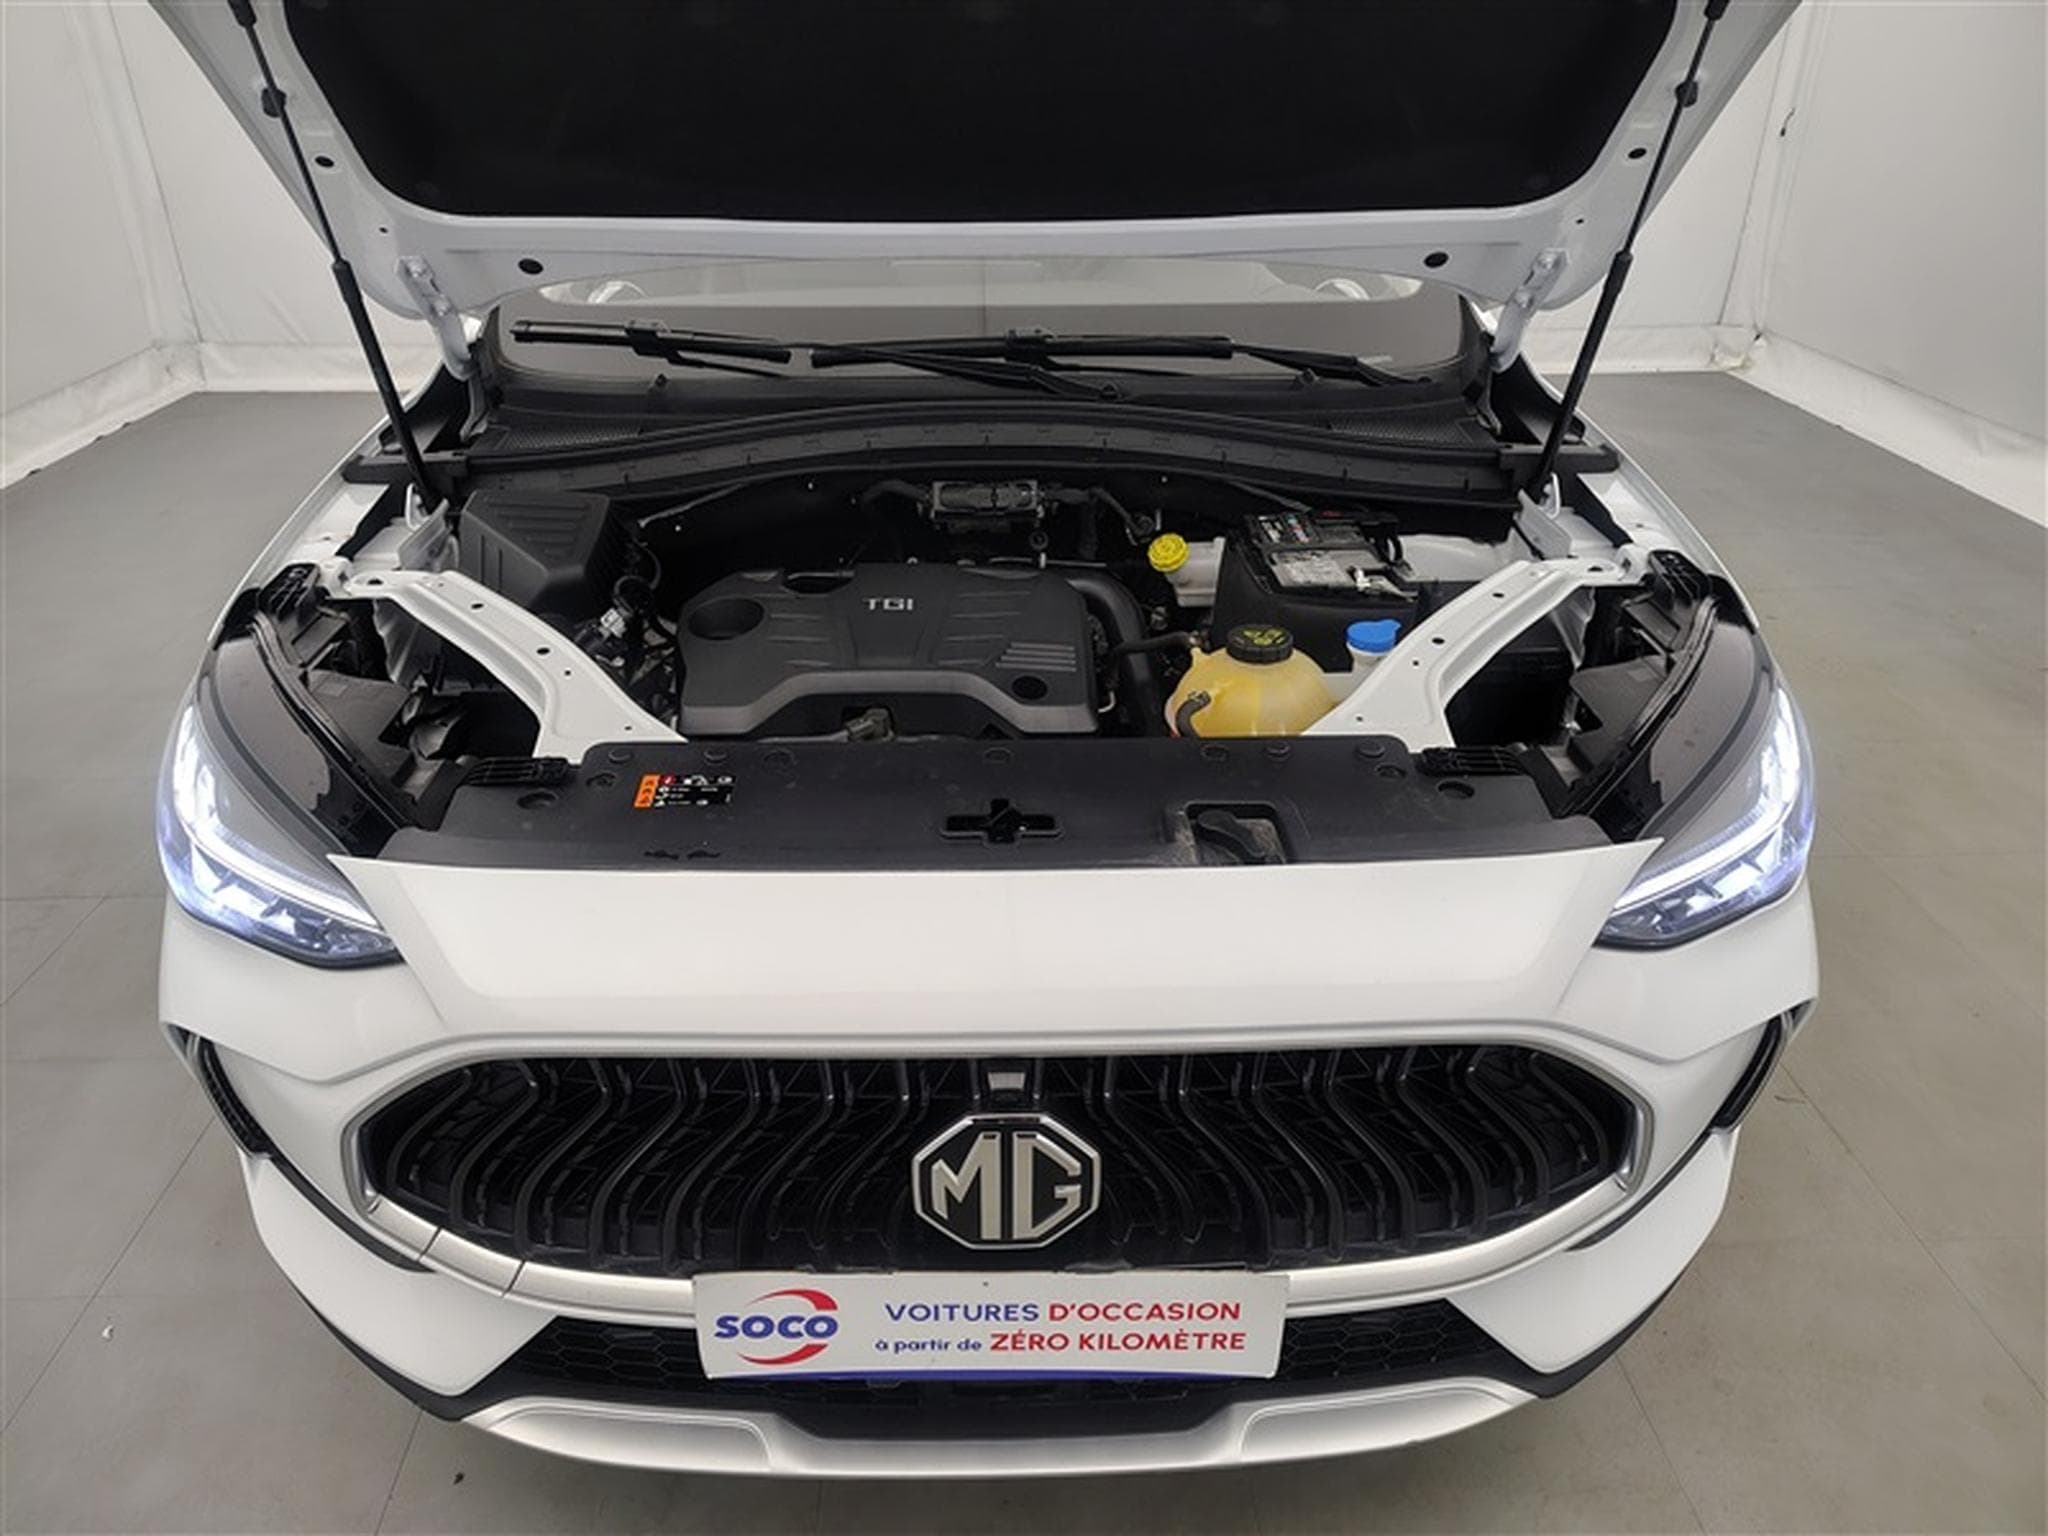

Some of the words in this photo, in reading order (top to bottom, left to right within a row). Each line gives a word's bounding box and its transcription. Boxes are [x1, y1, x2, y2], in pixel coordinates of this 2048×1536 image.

[864, 598, 913, 610] TGI
[931, 1132, 1081, 1240] MG
[886, 1303, 1040, 1322] VOITURES
[1049, 1302, 1241, 1321] D'OCCASION
[713, 1313, 839, 1340] SOCO
[875, 1337, 889, 1353] à
[893, 1337, 951, 1356] partir
[956, 1336, 982, 1351] de
[990, 1328, 1070, 1351] ZÉRO
[1078, 1328, 1246, 1351] KILOMÈTRE
